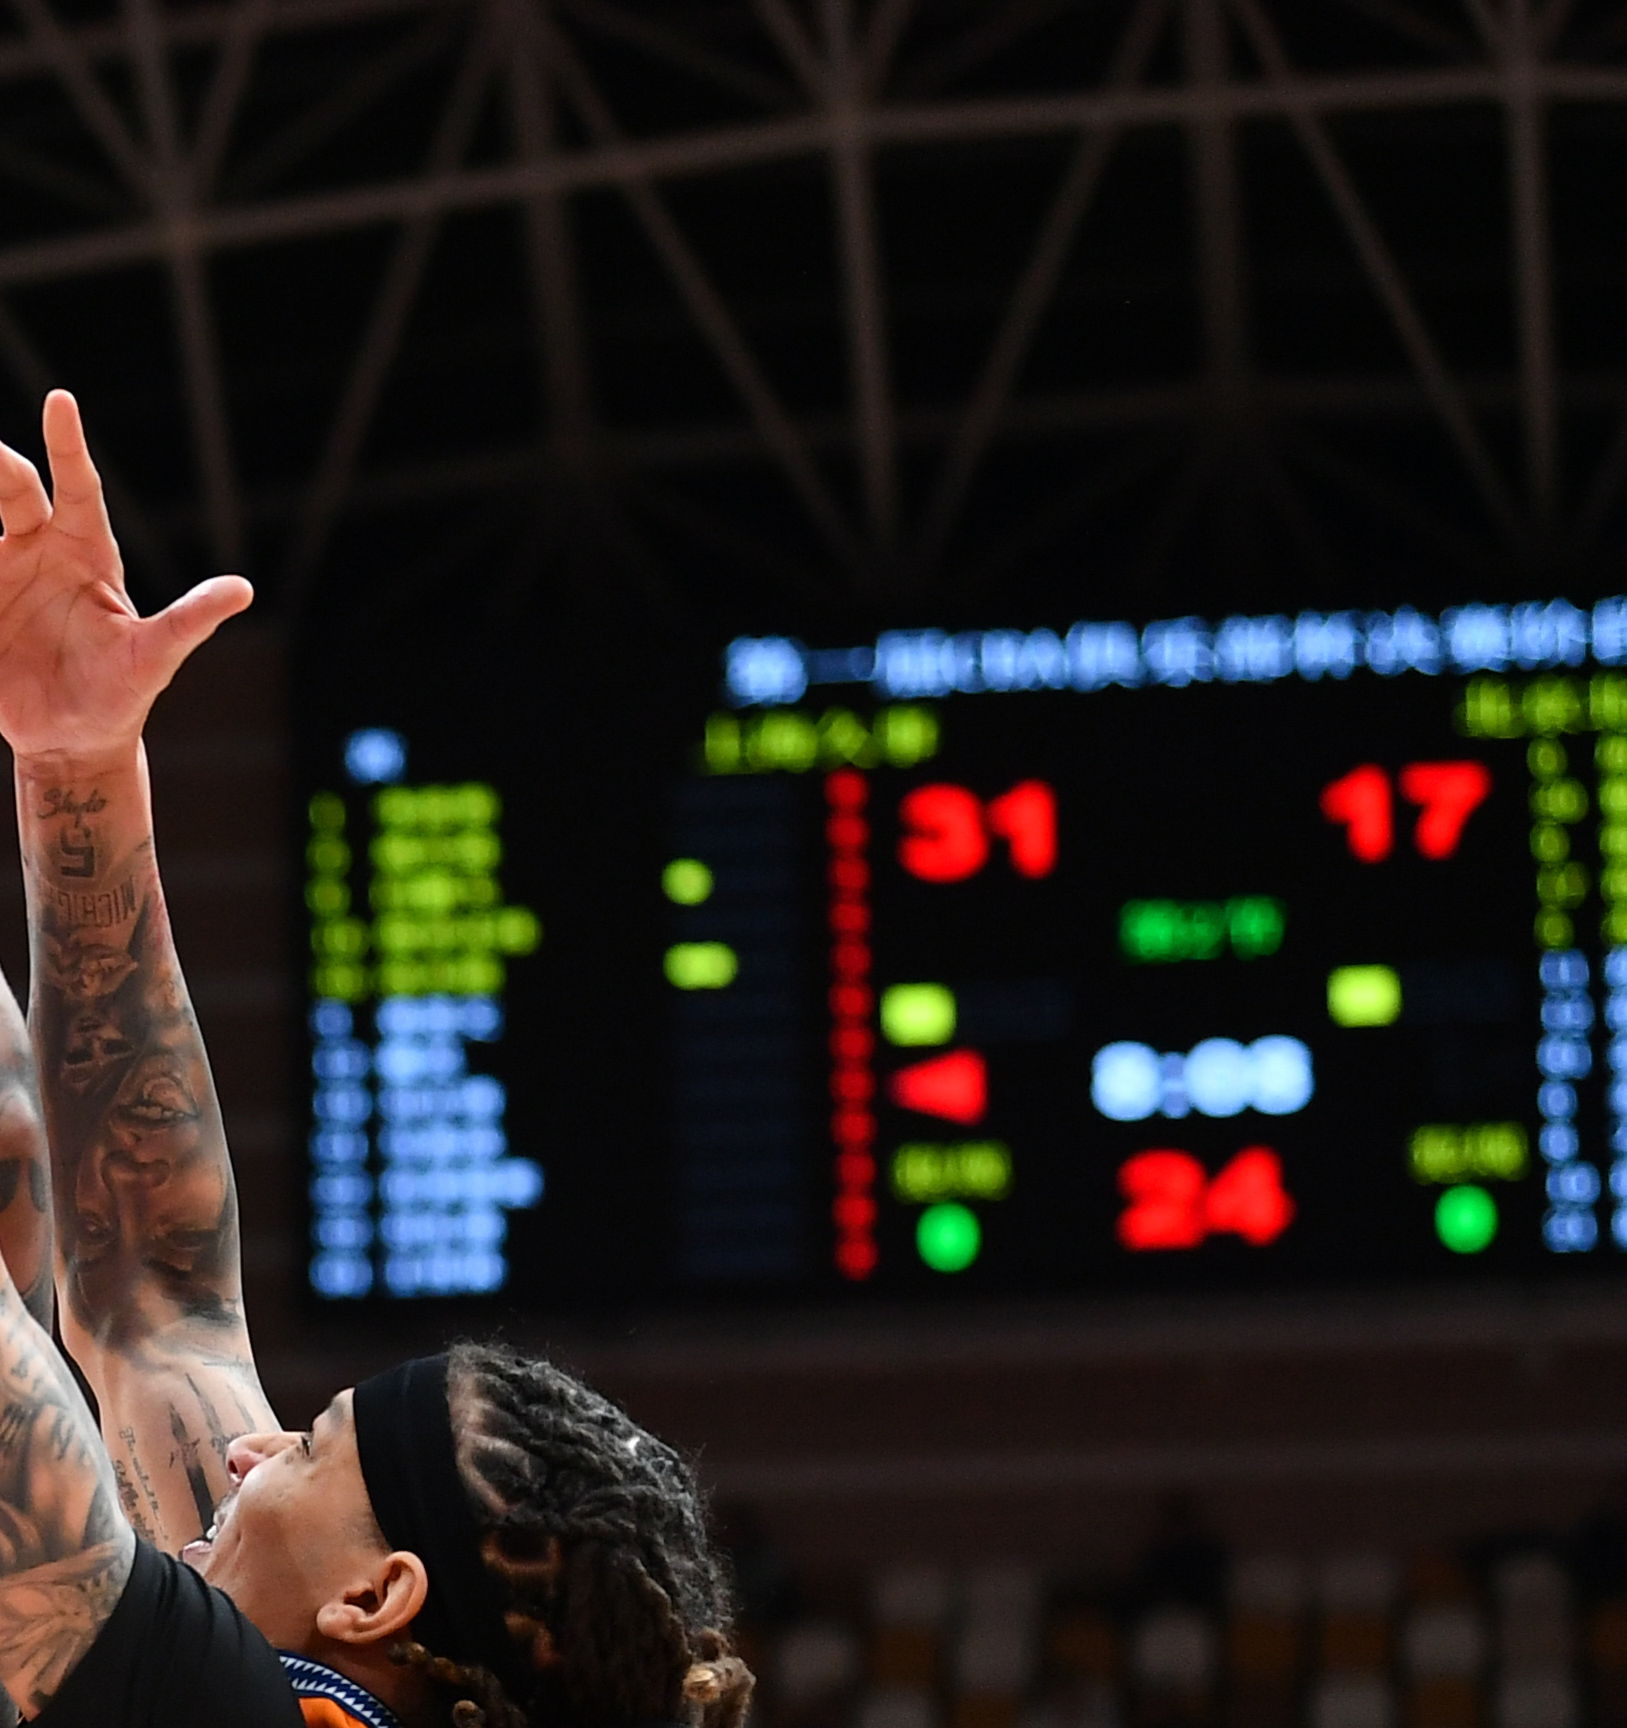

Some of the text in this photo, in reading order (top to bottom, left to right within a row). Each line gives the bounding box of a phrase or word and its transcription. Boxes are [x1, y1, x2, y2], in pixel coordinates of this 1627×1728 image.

[902, 780, 1057, 882] 31
[1321, 762, 1491, 862] 17
[1118, 1145, 1293, 1251] 24
